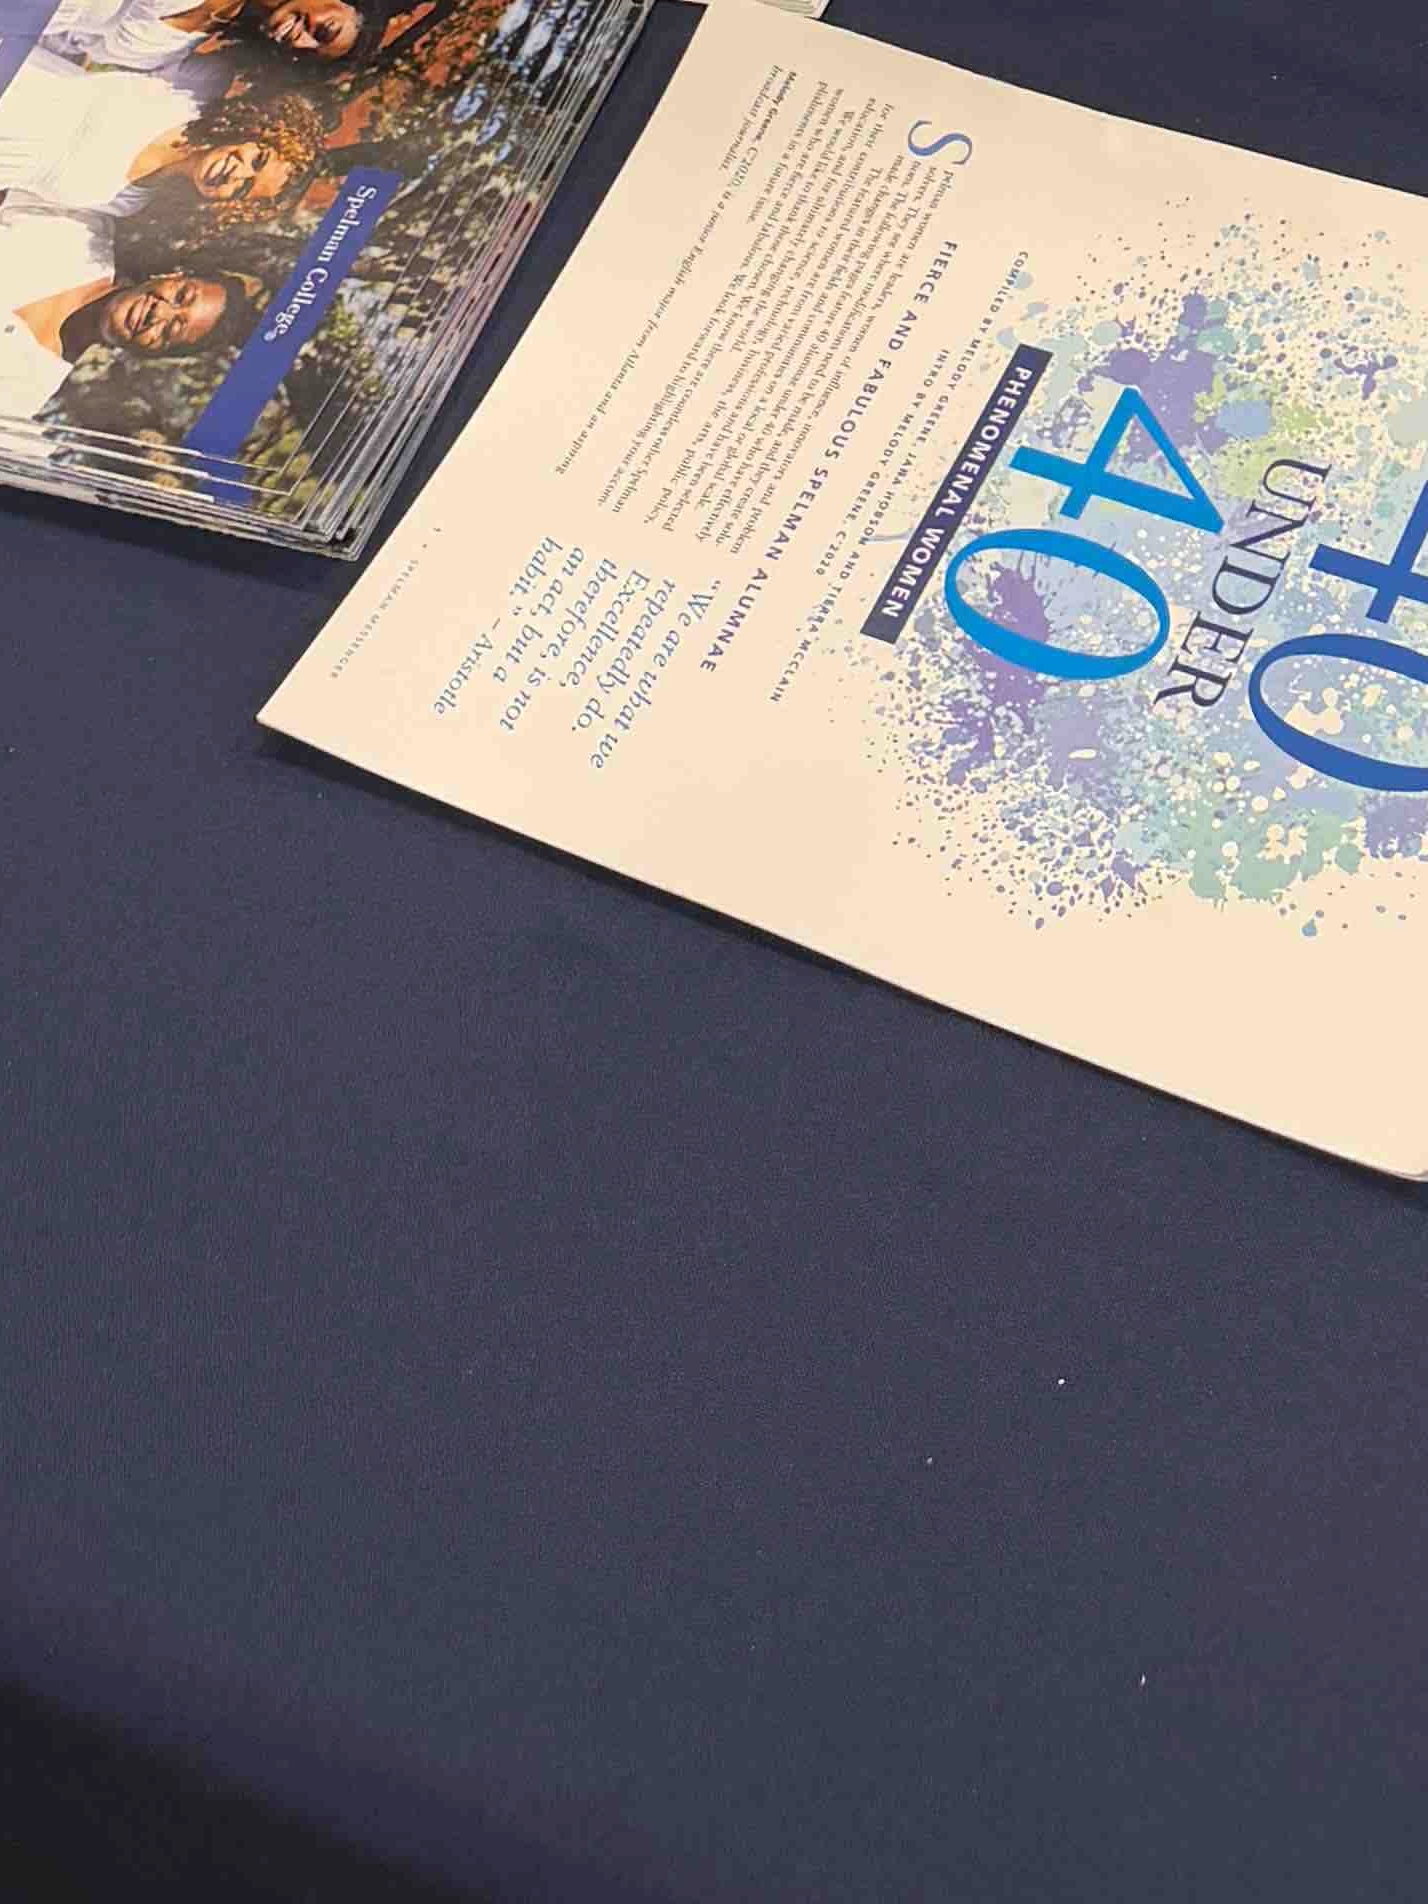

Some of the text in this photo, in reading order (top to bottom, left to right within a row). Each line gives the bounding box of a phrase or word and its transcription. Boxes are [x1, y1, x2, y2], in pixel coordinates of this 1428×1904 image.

[317, 185, 376, 261] Spelman
[700, 241, 957, 671] FIERCE AND FABULOUS SPELMAN ALUMNAE
[748, 462, 771, 485] they
[759, 484, 775, 505] and
[769, 251, 1028, 701] COMPILED BY MELODY GREENE, JANA HOBSON AND TIERRA MCCLAIN
[843, 349, 949, 523] INTRO BY MELODY GREENE,
[881, 366, 1032, 617] PHENOMENAL WOMEN
[729, 506, 762, 553] problem
[944, 384, 1225, 683] 40
[1152, 456, 1333, 711] UNDER
[433, 633, 492, 714] Aristotle
[490, 547, 583, 683] an act, but a
[499, 557, 617, 730] therefore, is not
[559, 569, 650, 687] Excellence,
[571, 579, 675, 731] repeatedly do.
[653, 629, 679, 667] are
[590, 733, 617, 768] we
[614, 671, 656, 729] what
